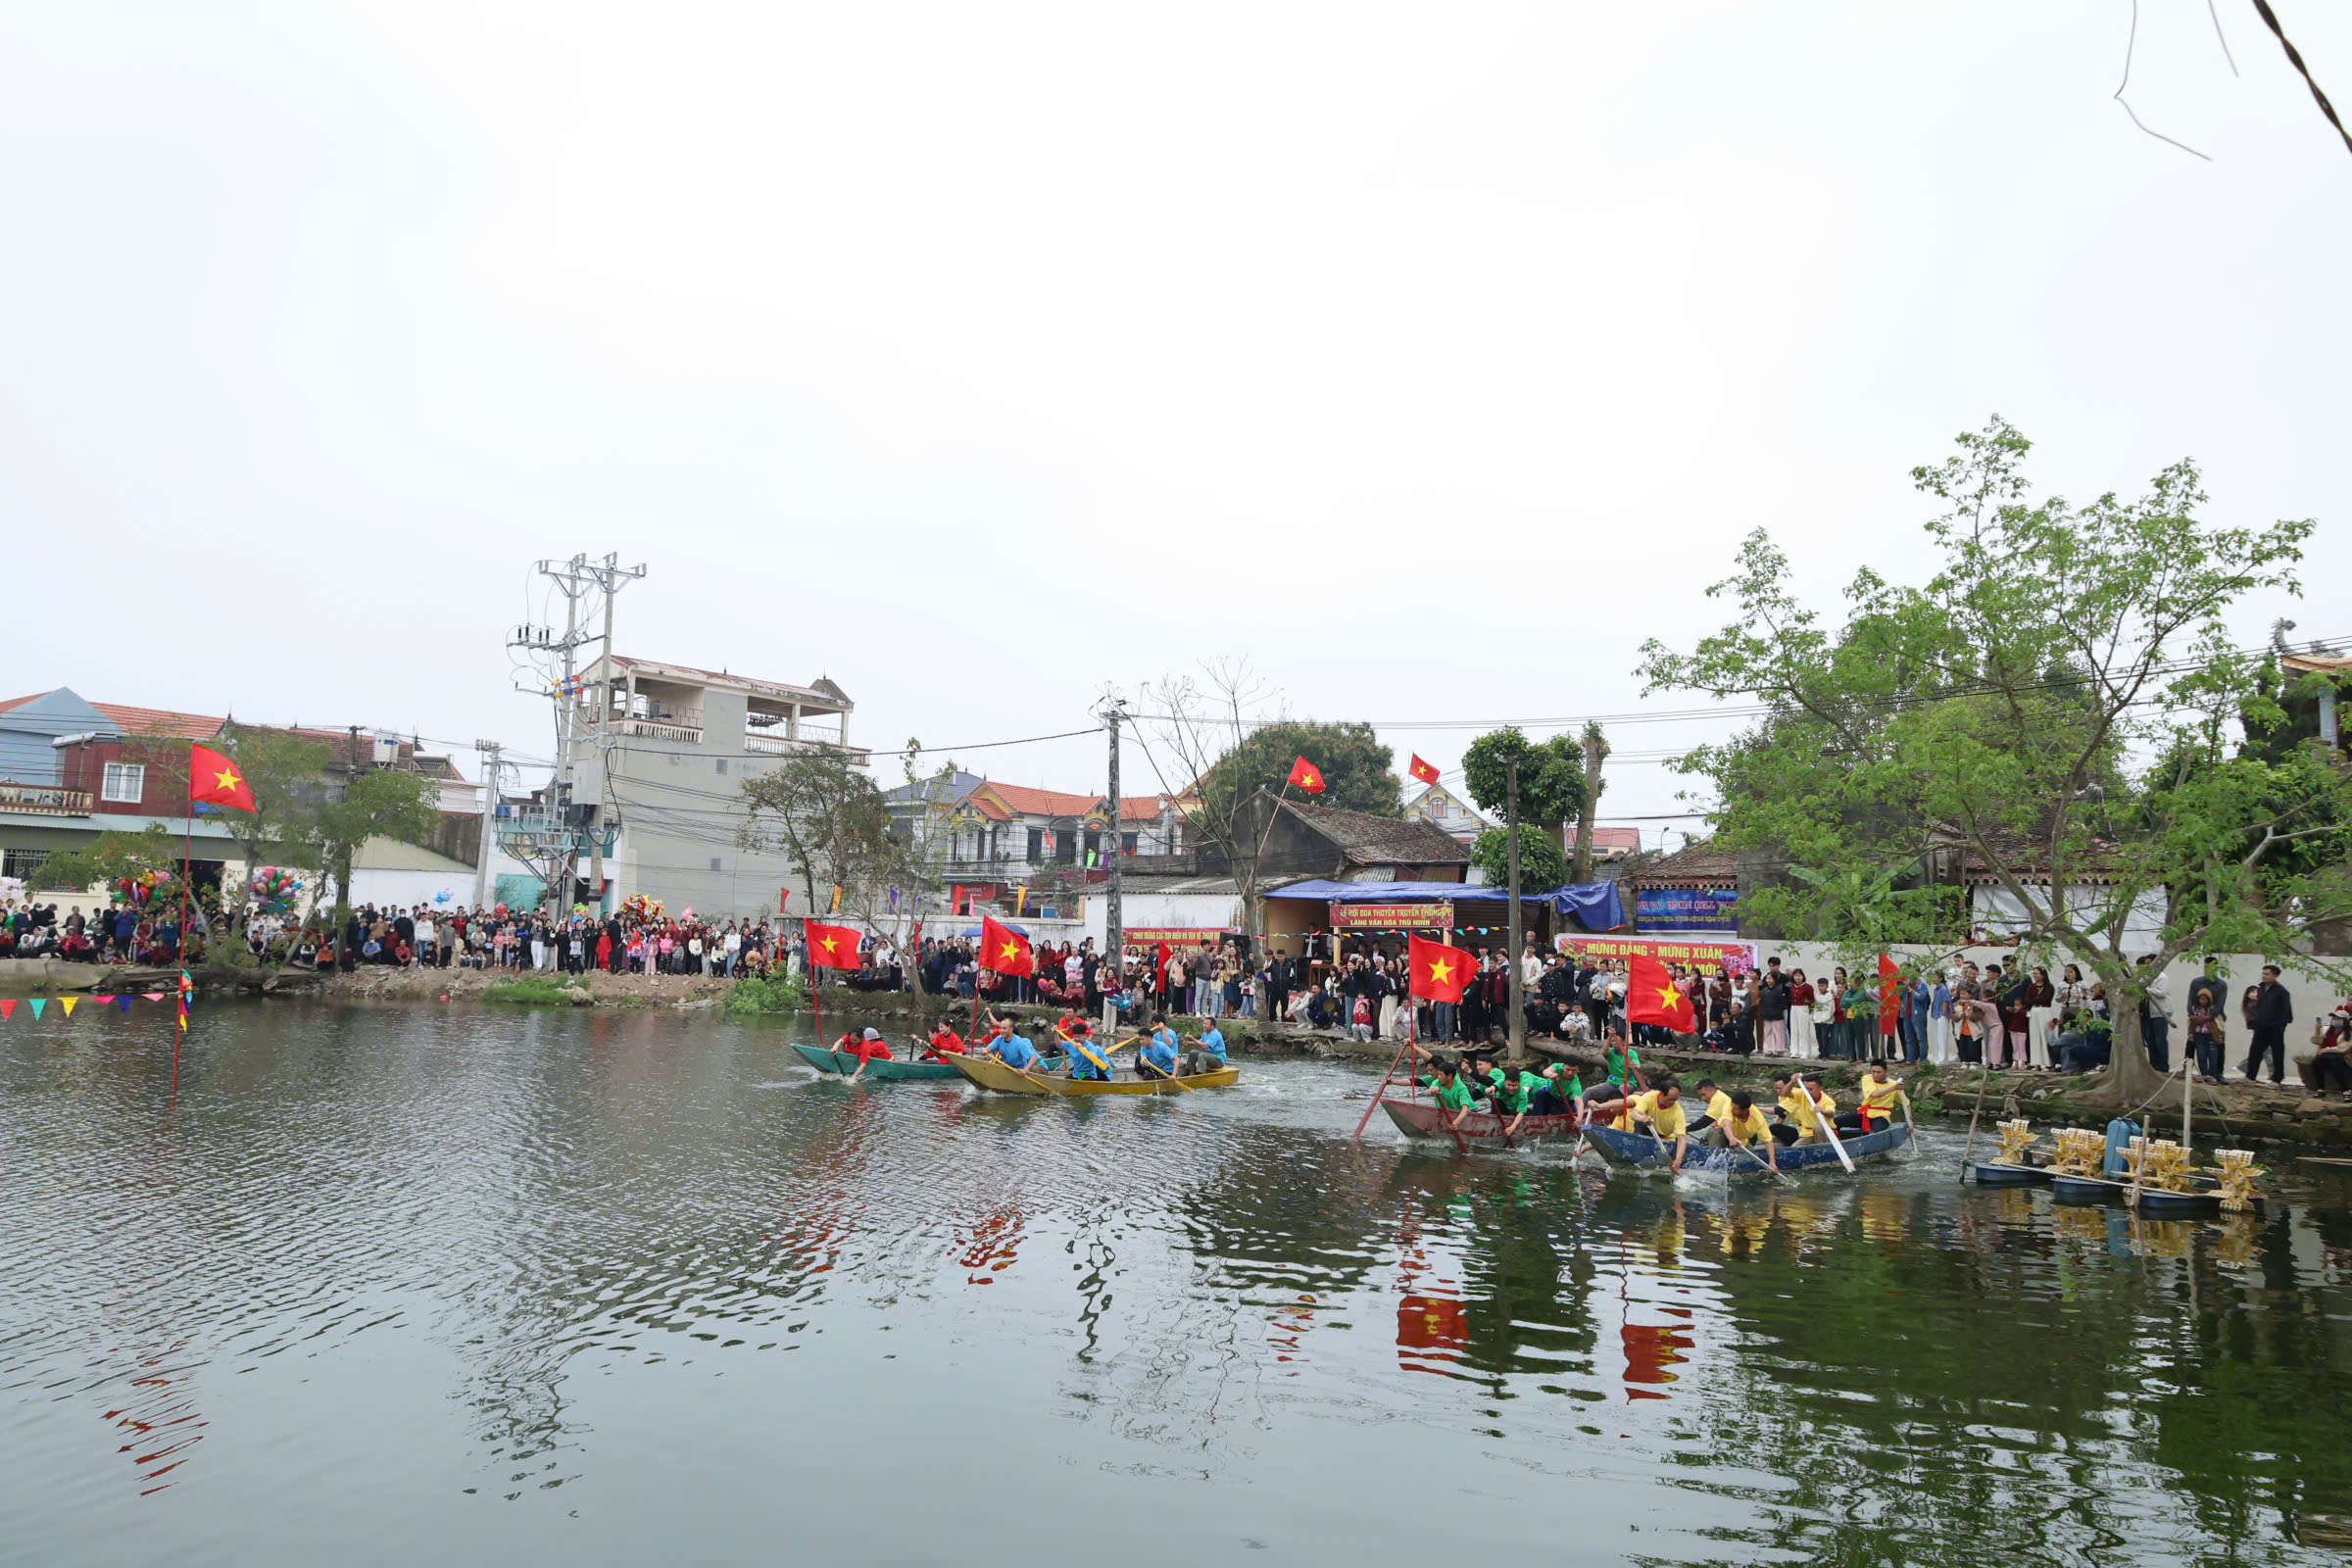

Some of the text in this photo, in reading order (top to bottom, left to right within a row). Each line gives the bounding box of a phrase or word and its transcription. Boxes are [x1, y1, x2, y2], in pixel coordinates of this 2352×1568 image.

[1587, 941, 1617, 956] MỪNG
[1619, 941, 1647, 956] ĐẢNG
[1657, 944, 1690, 958] MỪNG
[1692, 946, 1723, 959] XUÂN
